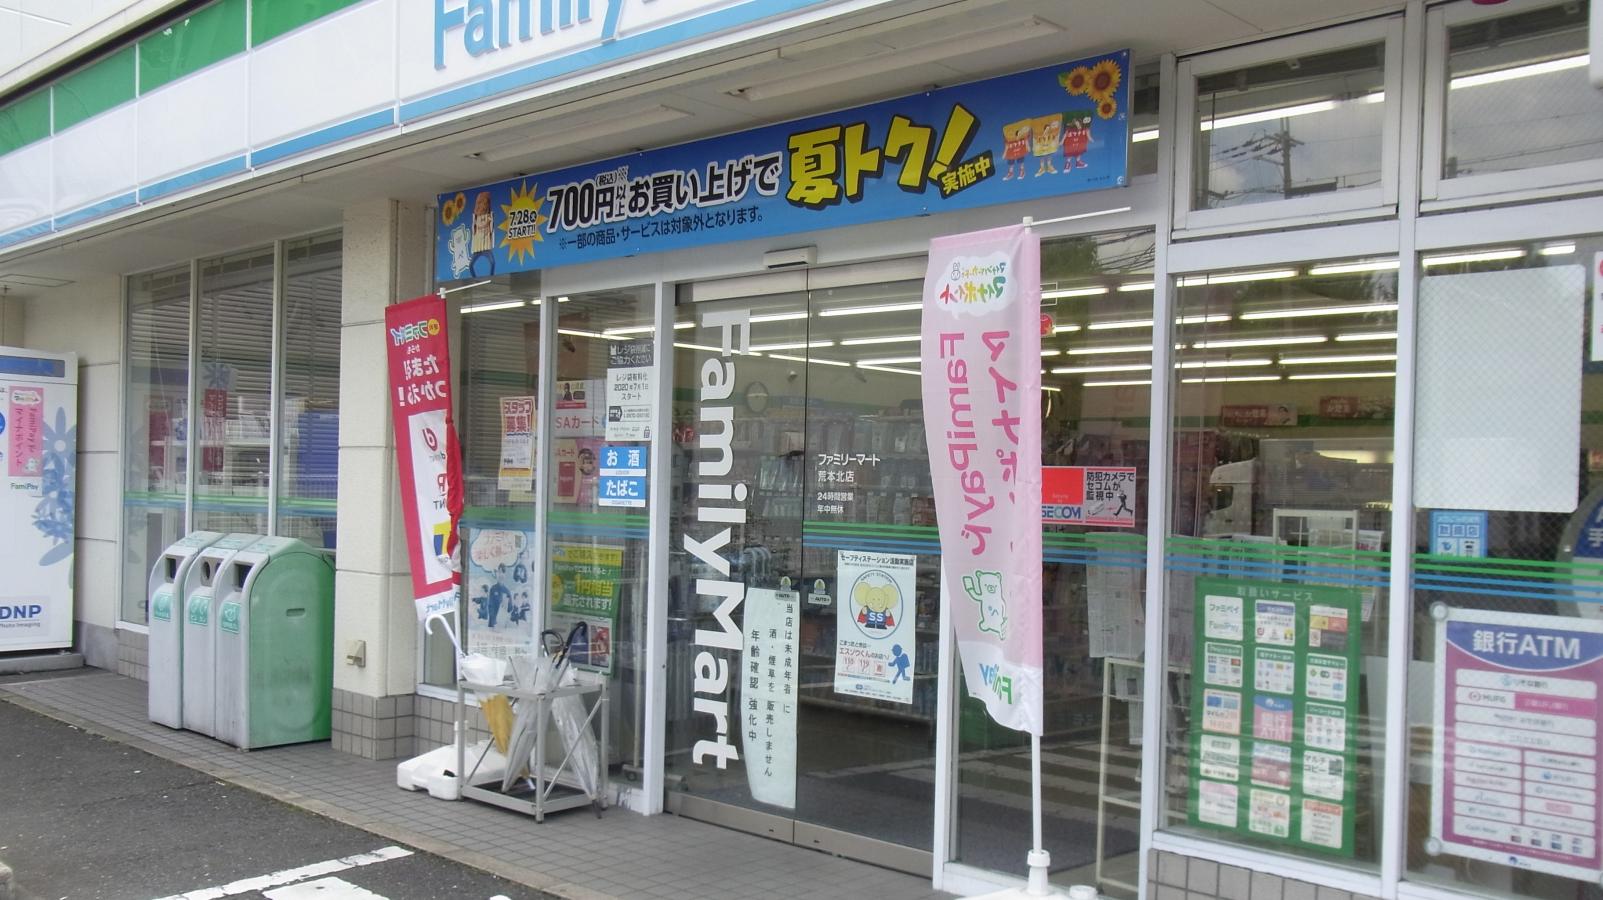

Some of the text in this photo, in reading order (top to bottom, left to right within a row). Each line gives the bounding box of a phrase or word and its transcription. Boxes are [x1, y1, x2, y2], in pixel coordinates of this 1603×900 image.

[942, 157, 992, 195] 実施中
[621, 392, 642, 401] スタート
[818, 453, 881, 467] ファミリーマート
[817, 471, 855, 482] 荒本北店
[1086, 471, 1135, 482] 防犯カメラで
[10, 483, 39, 492] FamiPay
[606, 480, 639, 496] たばこ
[1086, 482, 1121, 491] セコムが
[817, 492, 854, 502] 24時間営業
[1086, 491, 1114, 501] 監視中
[683, 308, 752, 770] FamilyMart
[0, 605, 41, 620] DNP
[869, 611, 884, 622] SS
[1472, 629, 1581, 660] 銀行ATM
